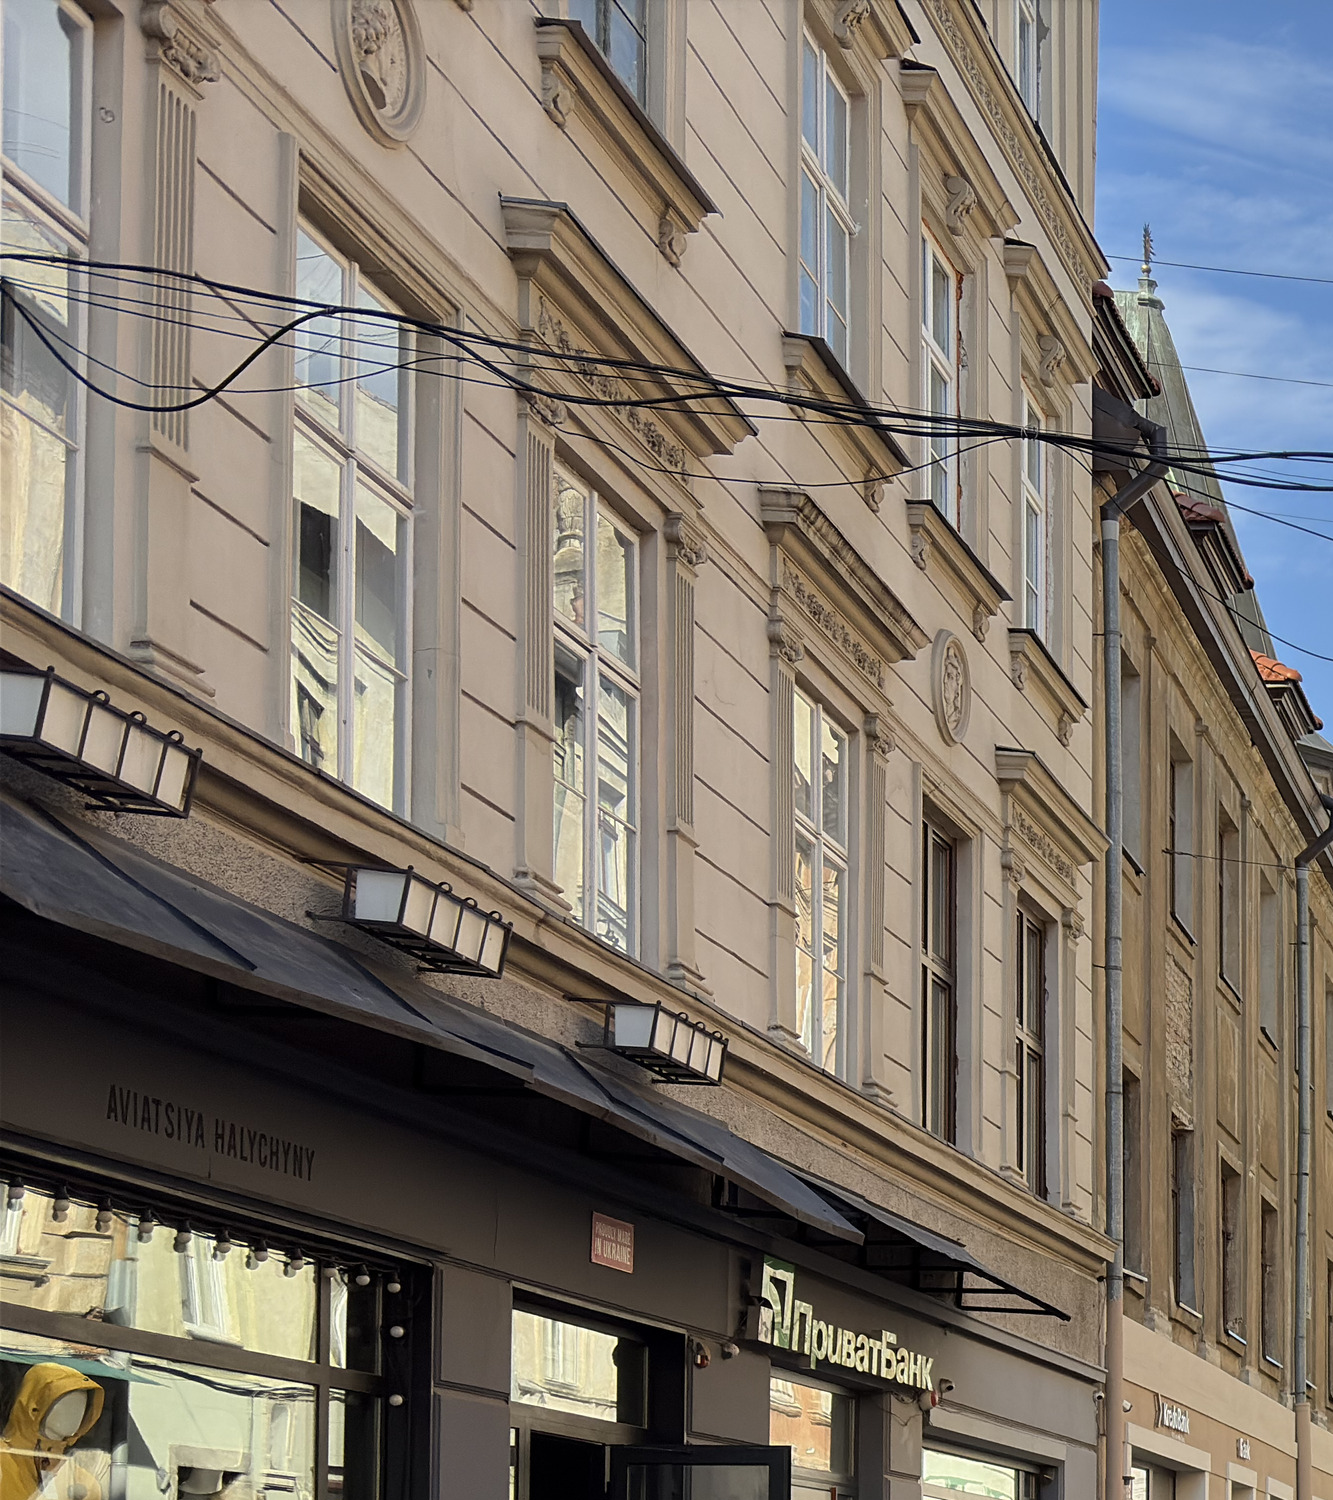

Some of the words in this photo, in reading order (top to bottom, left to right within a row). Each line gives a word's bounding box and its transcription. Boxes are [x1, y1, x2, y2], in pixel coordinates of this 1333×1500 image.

[106, 1083, 206, 1149] AVIATSIYA
[214, 1118, 315, 1182] HALYCHYNY
[594, 1237, 602, 1256] IN
[603, 1239, 631, 1265] UKRAINE
[791, 1299, 934, 1392] ПриватБанк
